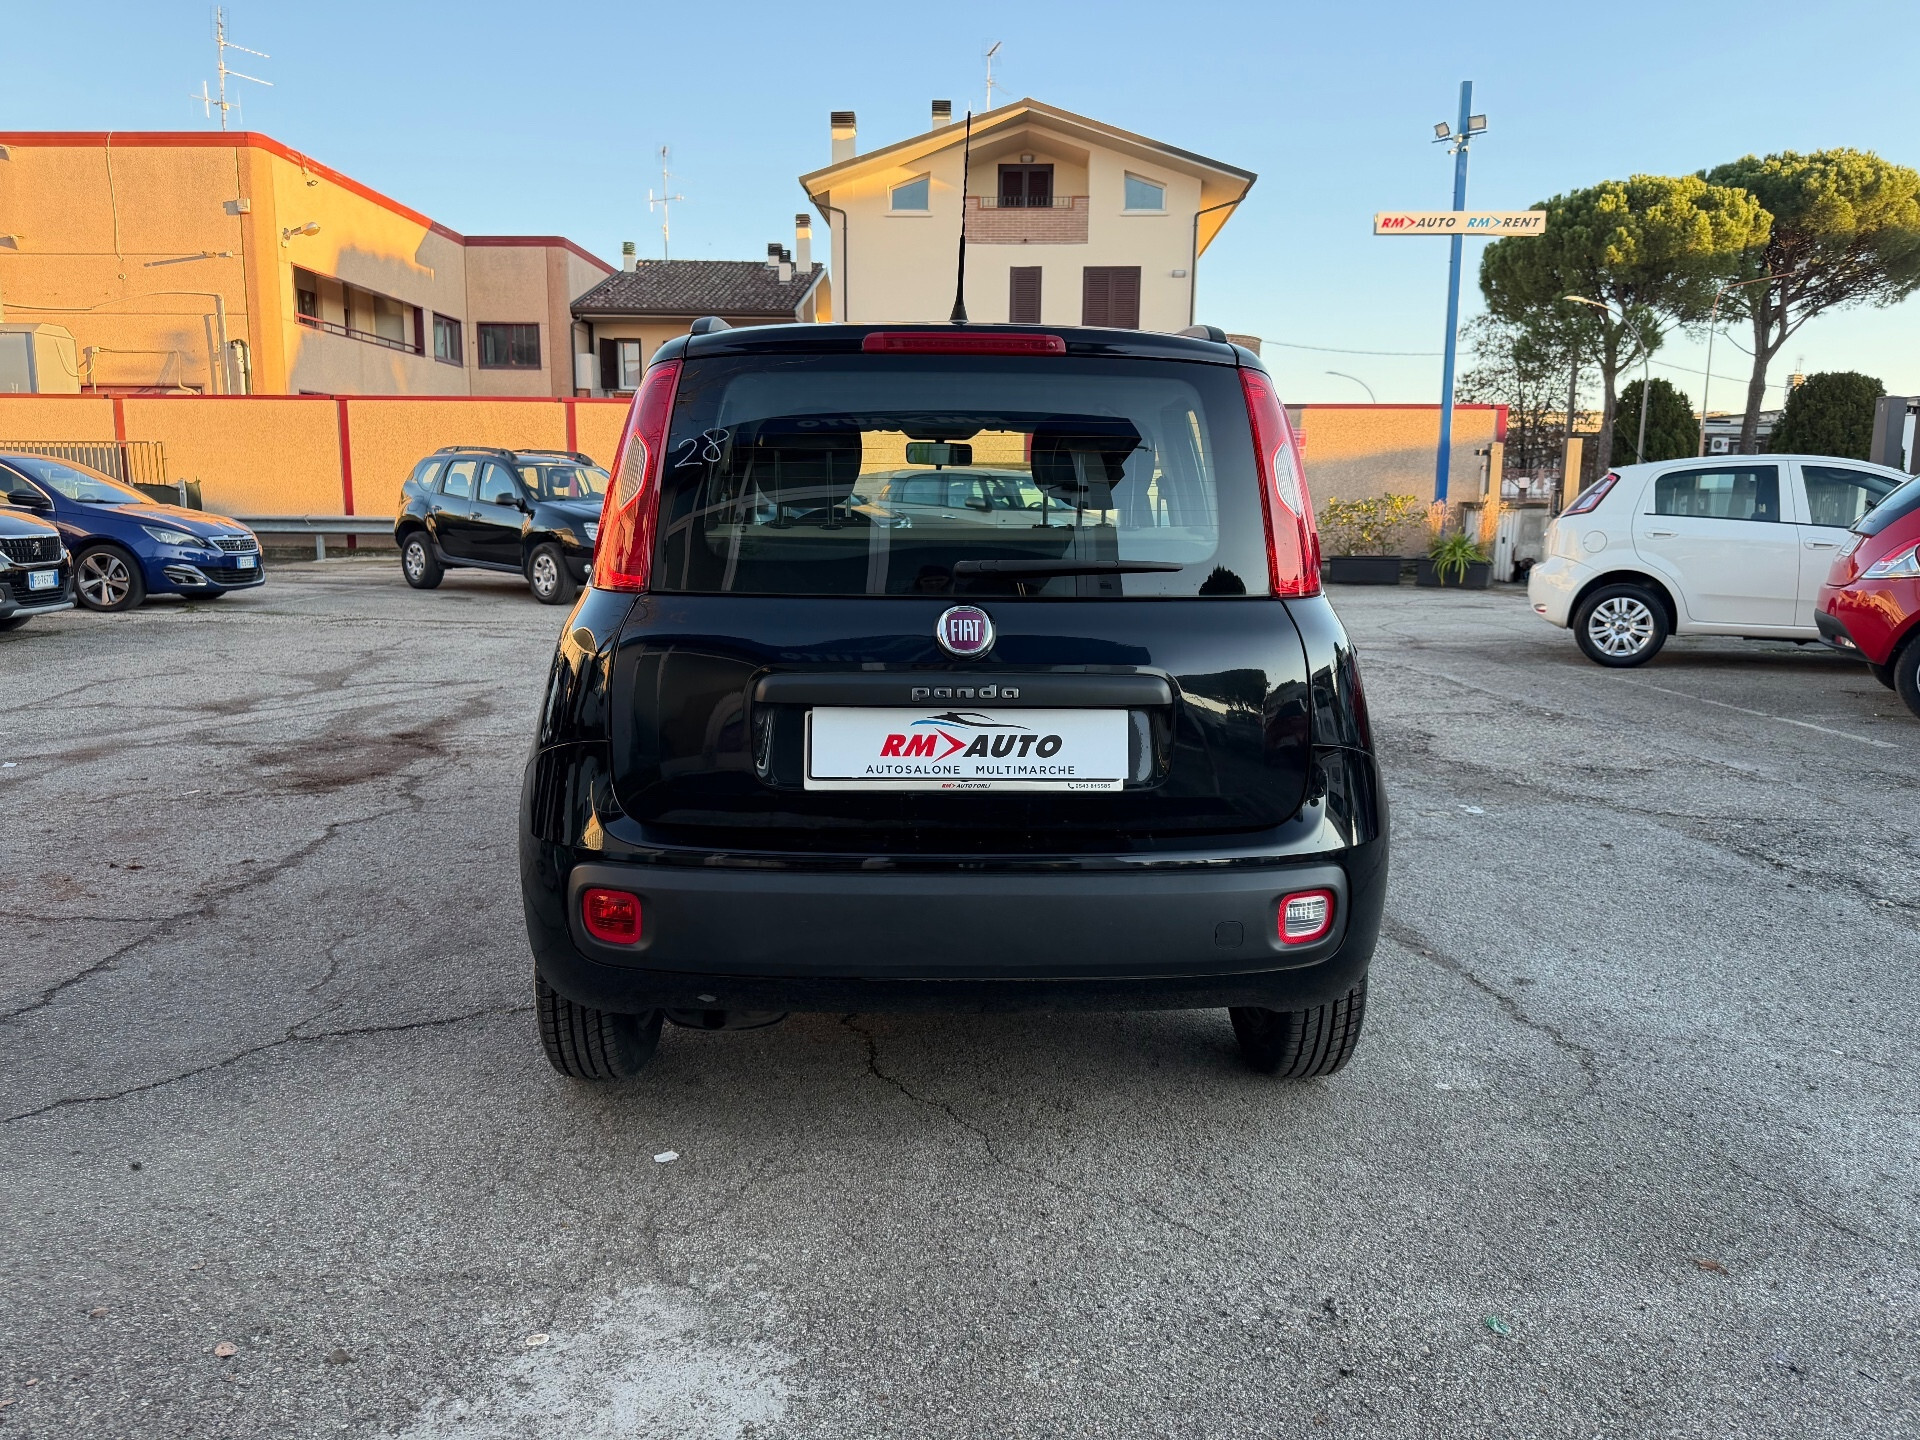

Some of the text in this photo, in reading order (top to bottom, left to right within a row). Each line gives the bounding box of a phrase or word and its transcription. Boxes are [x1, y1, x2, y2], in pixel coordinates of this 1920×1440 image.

[1381, 217, 1541, 229] RM AUTO RM RENT
[674, 427, 730, 469] 28
[950, 619, 982, 642] FIAT
[911, 683, 1020, 702] panda
[880, 733, 1063, 758] RM AUTO
[865, 764, 1075, 775] AUTOSALONE MULTIMARCHE
